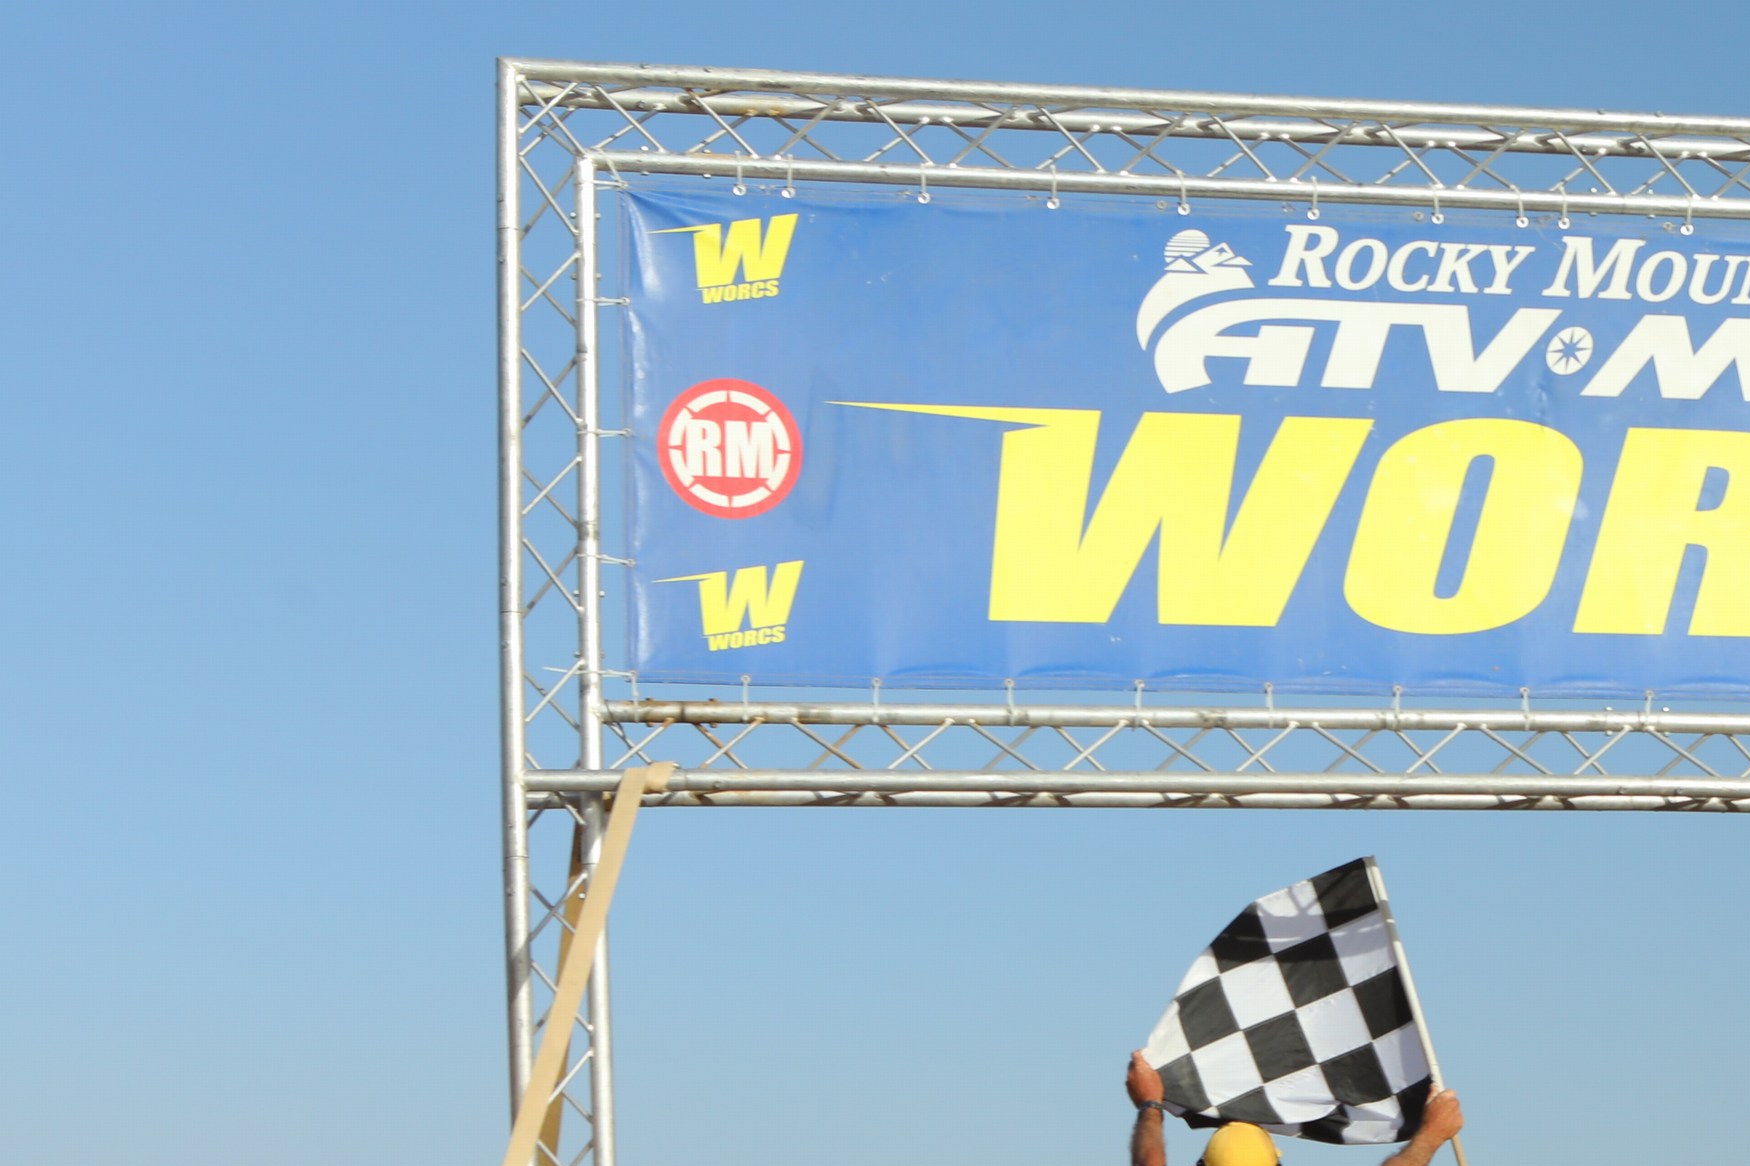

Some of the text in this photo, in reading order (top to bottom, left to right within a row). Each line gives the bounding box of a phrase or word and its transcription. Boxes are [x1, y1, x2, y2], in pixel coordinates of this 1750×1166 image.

[648, 213, 799, 288] W
[1268, 224, 1535, 297] ROCKY
[702, 279, 780, 304] WORCS
[682, 419, 777, 480] RM
[651, 560, 805, 637] W
[707, 625, 787, 651] WORCS
